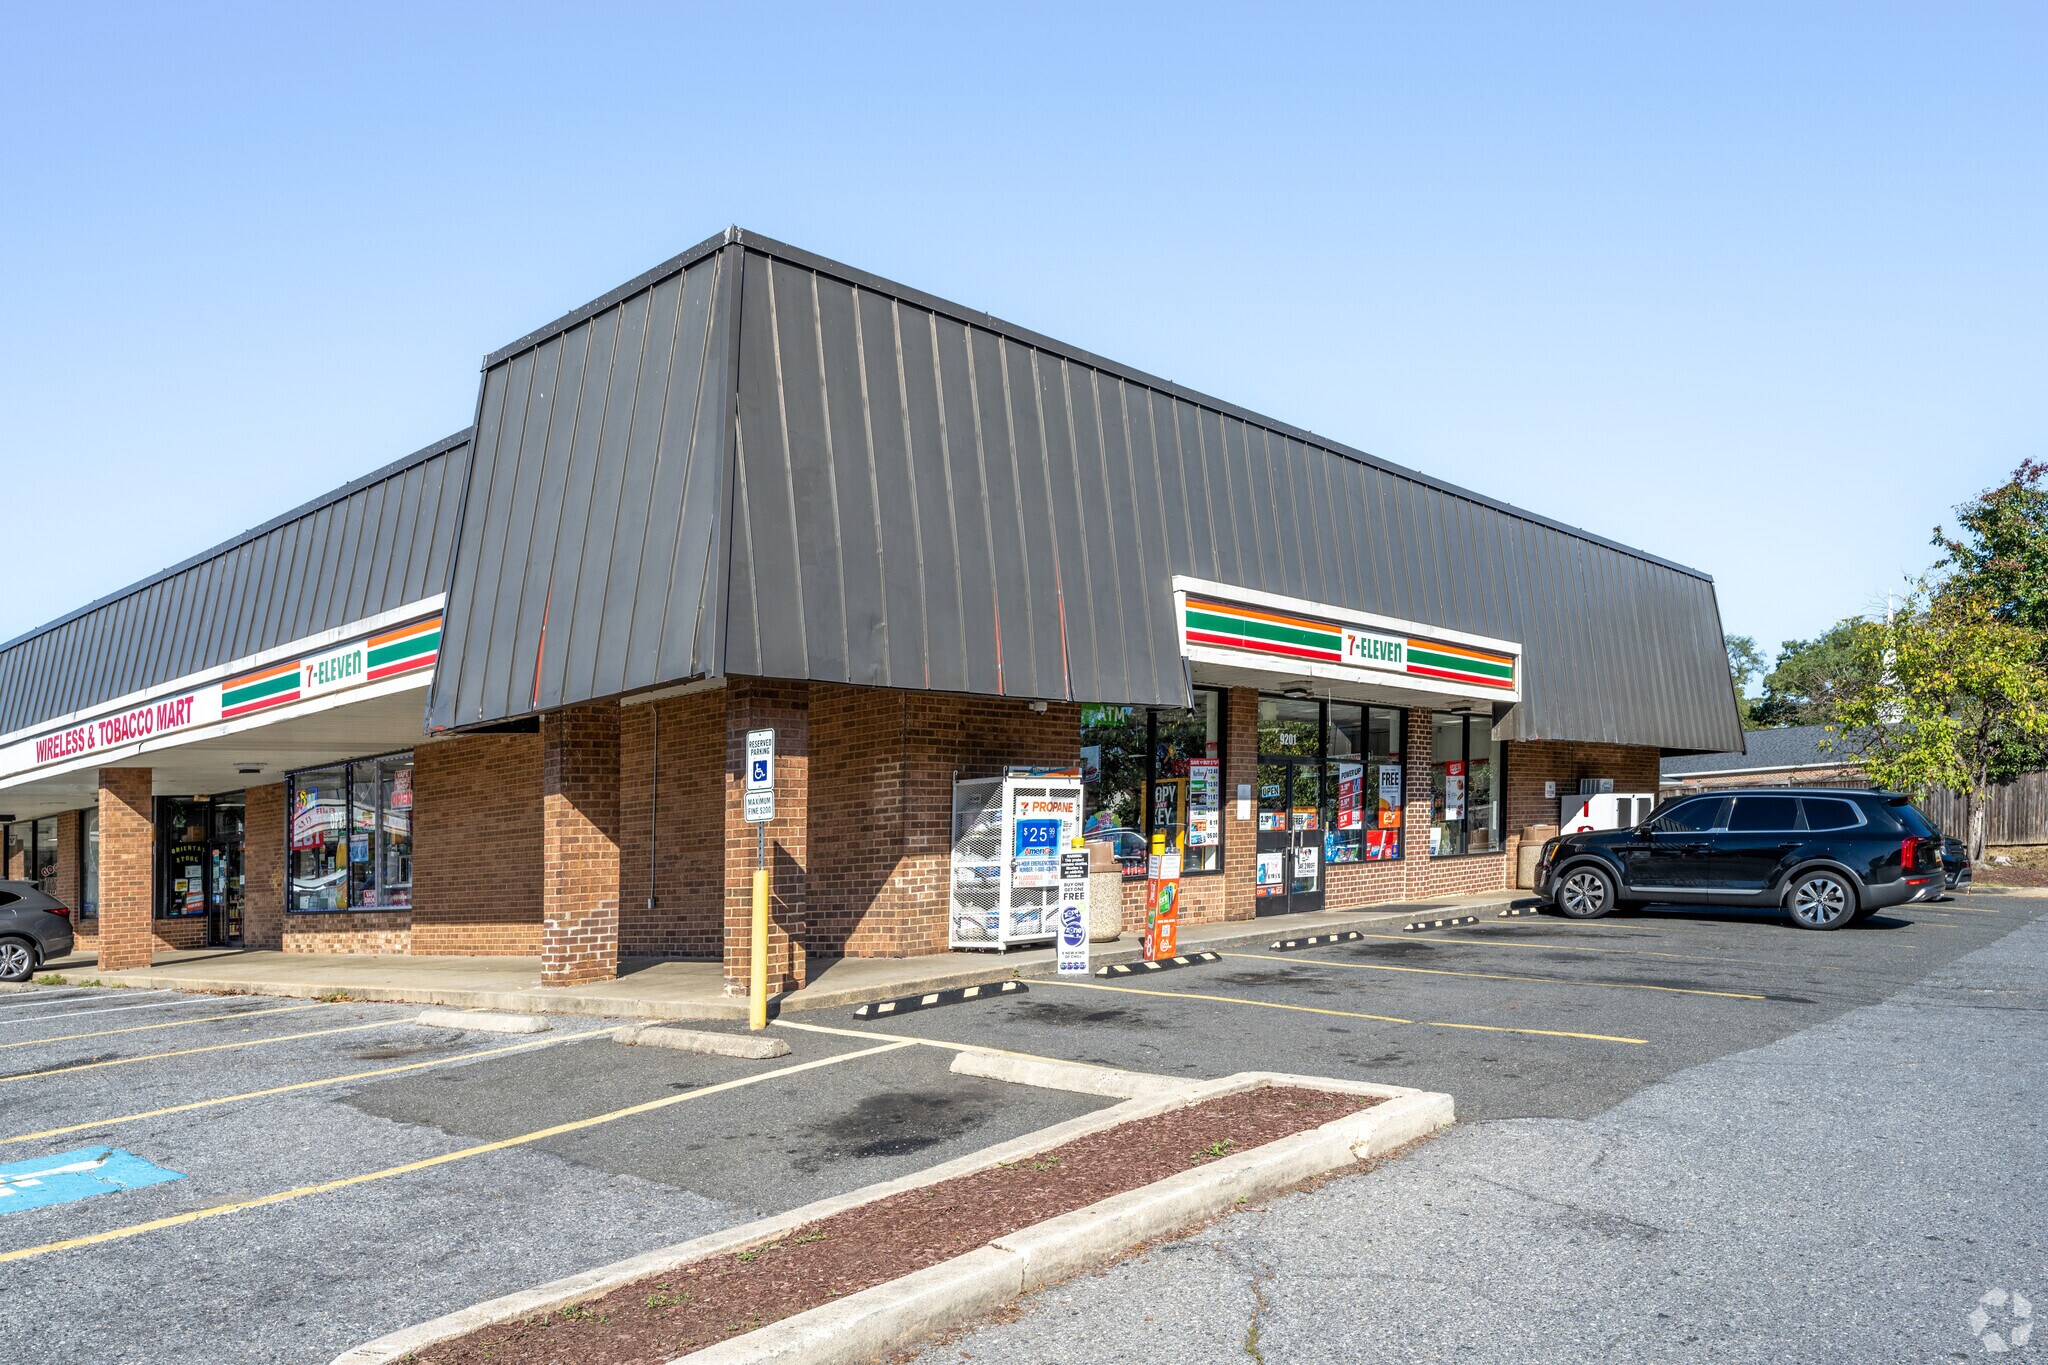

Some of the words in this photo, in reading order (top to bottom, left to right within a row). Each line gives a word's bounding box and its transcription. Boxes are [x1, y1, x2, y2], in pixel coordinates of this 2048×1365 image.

[1097, 706, 1125, 722] ATM
[36, 728, 85, 763] WIRELESS
[88, 724, 95, 749] &
[99, 708, 153, 746] TOBACCO
[156, 696, 194, 732] MART
[749, 738, 771, 748] RESERVED
[1280, 734, 1296, 745] 9201
[750, 747, 770, 756] PARKING
[1341, 770, 1354, 779] POWER
[1382, 772, 1399, 786] FREE
[1155, 785, 1176, 803] OPY
[1262, 786, 1279, 796] OPEN
[392, 792, 412, 806] OPEN
[748, 797, 770, 806] MAXIMUM
[760, 806, 771, 814] $200
[1032, 801, 1073, 812] PROPANE
[331, 812, 346, 829] OPE
[172, 846, 205, 854] ORIENTAL
